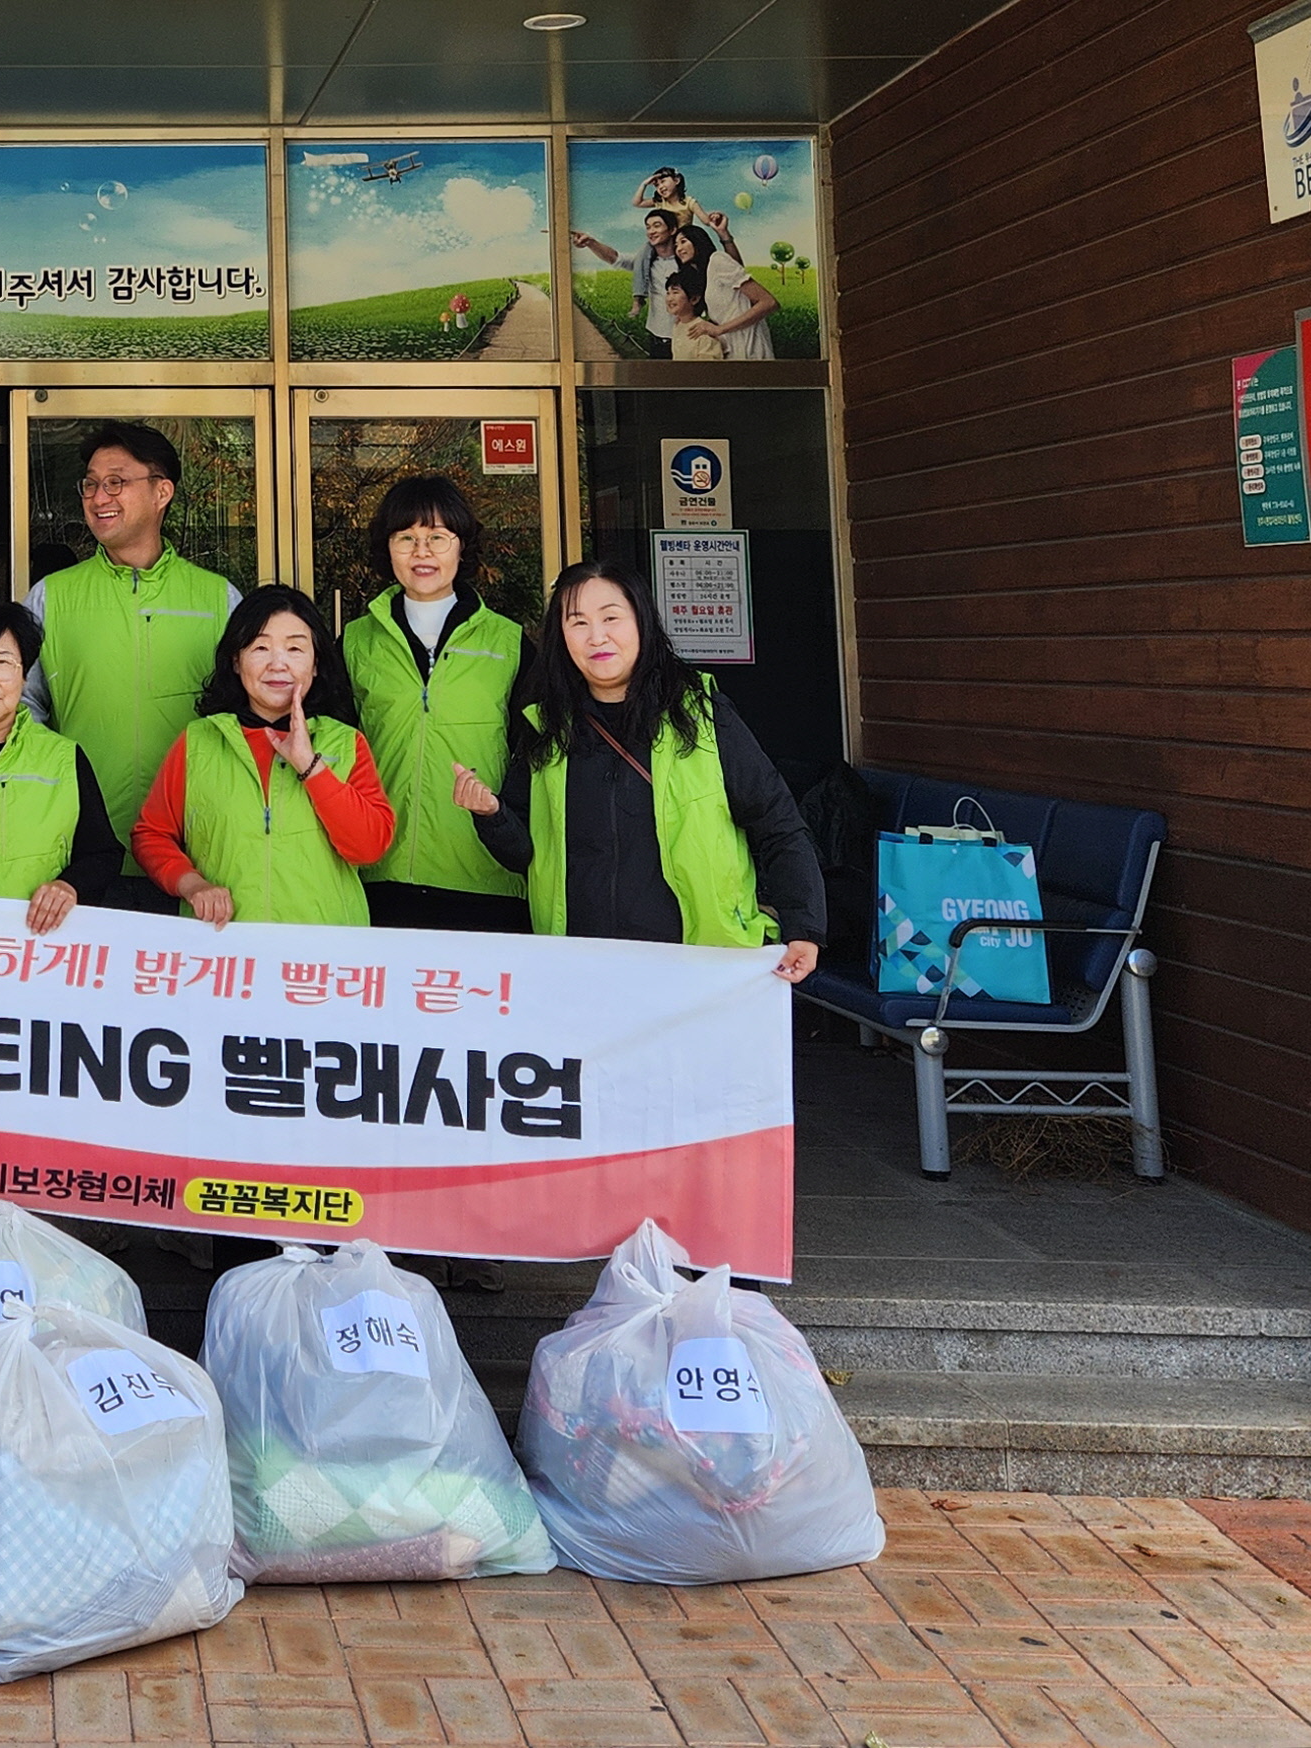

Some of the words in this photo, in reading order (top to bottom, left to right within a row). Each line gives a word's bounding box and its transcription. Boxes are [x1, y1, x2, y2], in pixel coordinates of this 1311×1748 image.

[107, 266, 263, 300] 감사합니다.
[491, 438, 527, 453] 에스원
[679, 496, 716, 507] 금연건물
[693, 539, 741, 552] 운영시간안내
[941, 897, 1030, 922] GYEONG
[979, 936, 1002, 949] City
[132, 948, 257, 1000] 밝게!
[281, 960, 387, 1009] 빨래
[411, 967, 513, 1016] 끝~!
[221, 1034, 584, 1141] 빨래사업
[198, 1181, 354, 1223] 꼼꼼복지단
[335, 1316, 420, 1353] 정해숙
